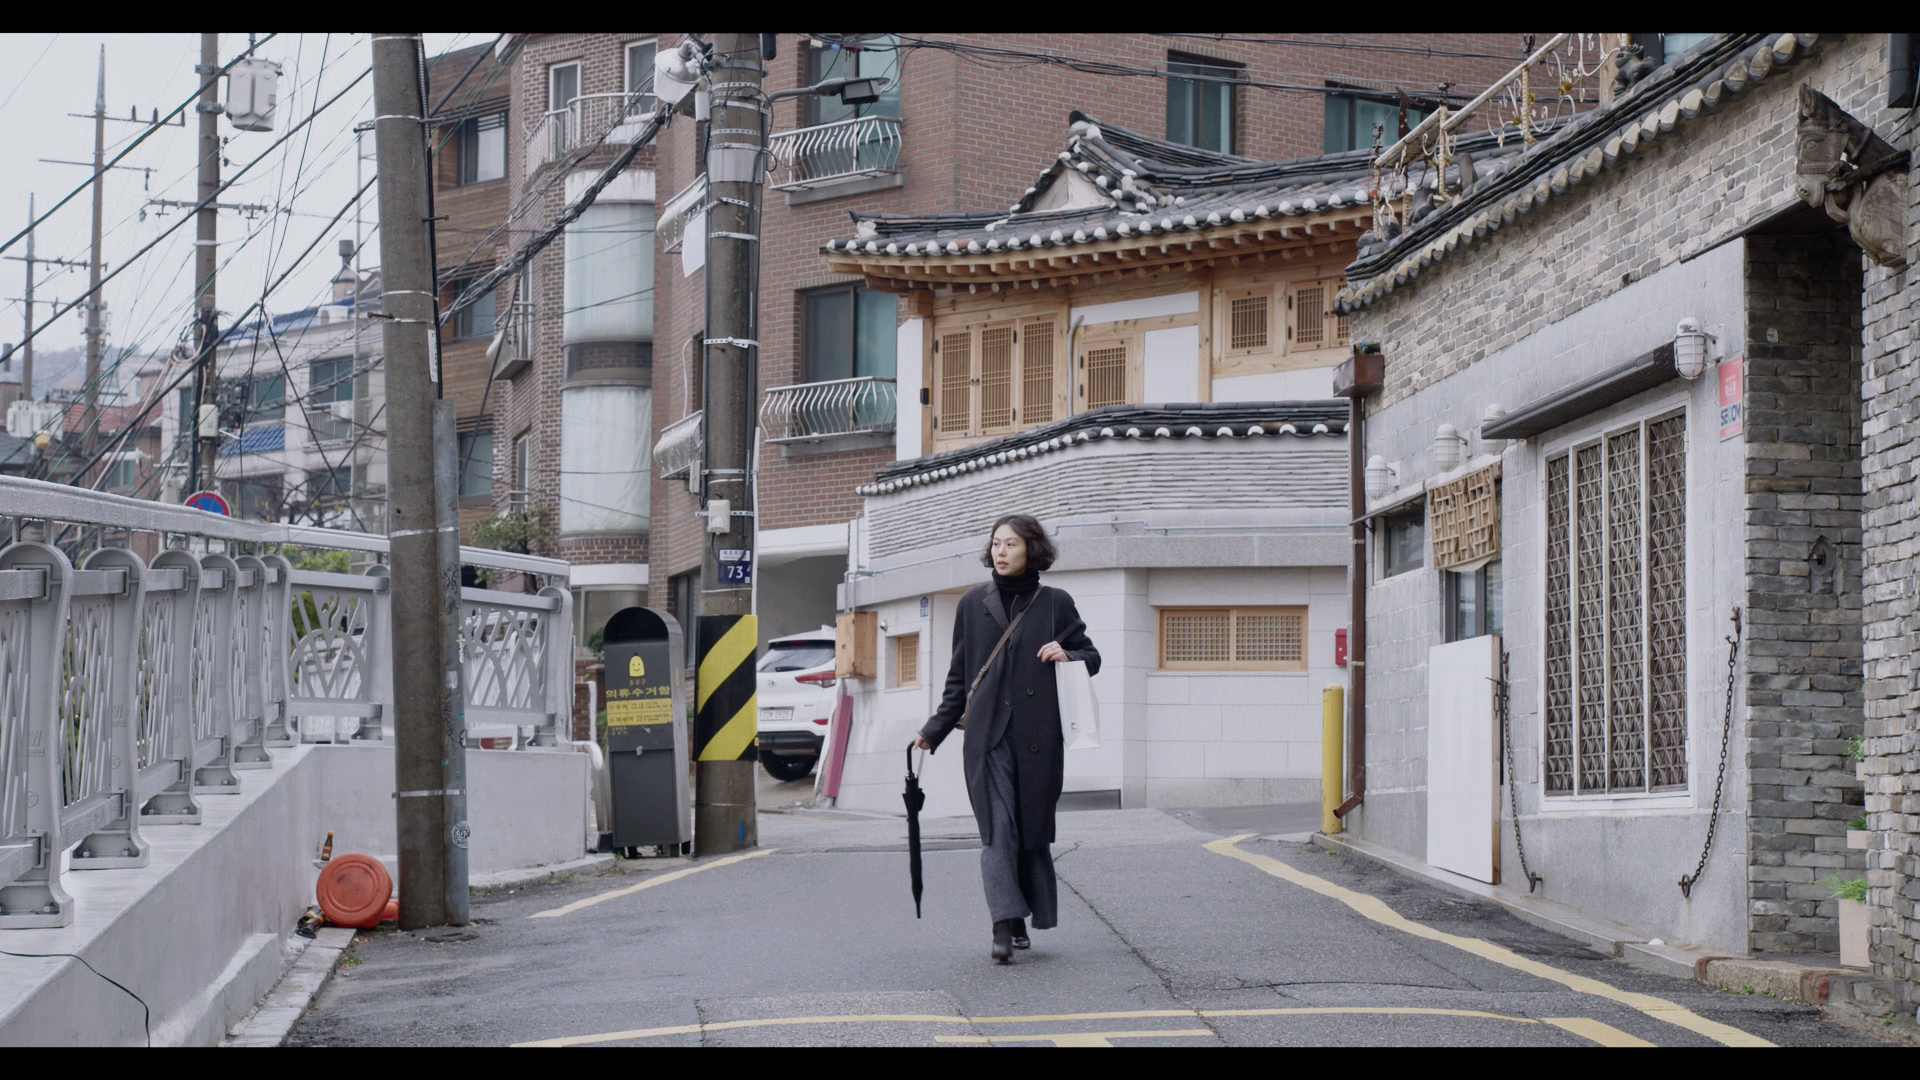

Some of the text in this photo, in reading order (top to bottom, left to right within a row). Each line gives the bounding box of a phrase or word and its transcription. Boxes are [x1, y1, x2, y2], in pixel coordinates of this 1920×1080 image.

[1720, 401, 1741, 426] SECOM
[727, 565, 743, 579] 73
[605, 685, 671, 698] 의류수거함
